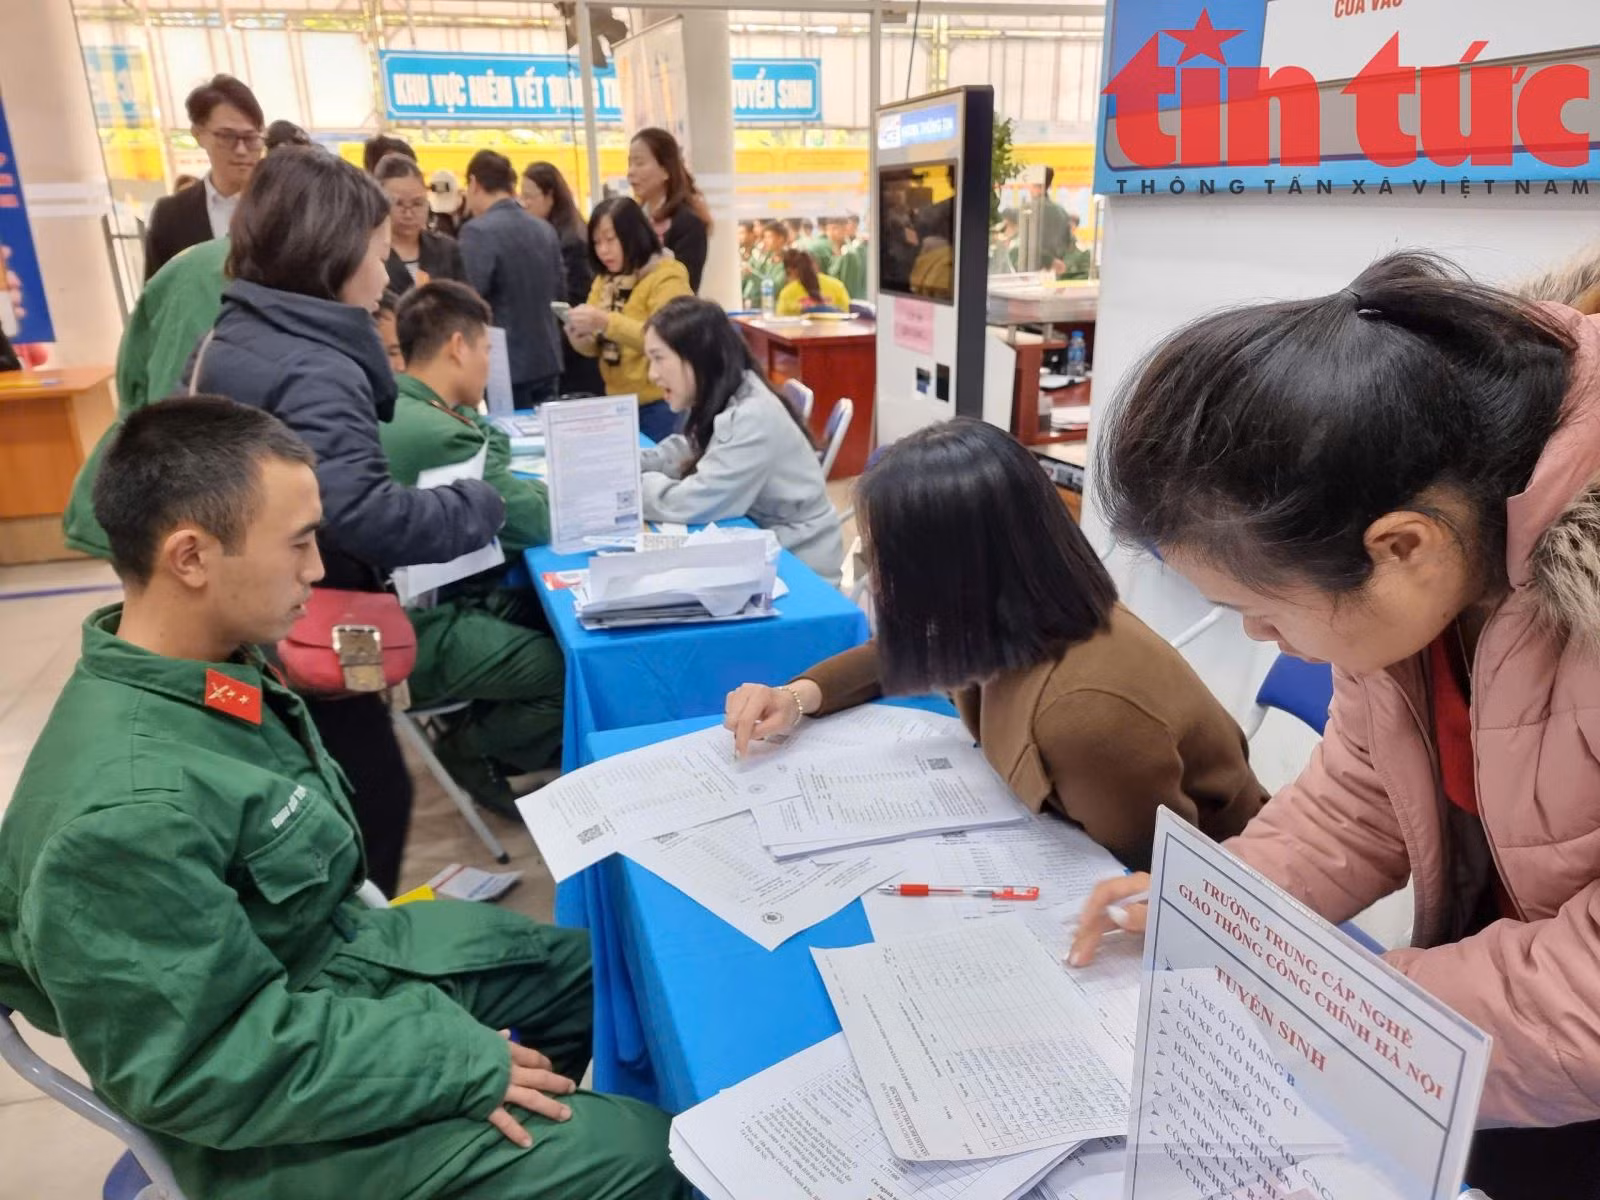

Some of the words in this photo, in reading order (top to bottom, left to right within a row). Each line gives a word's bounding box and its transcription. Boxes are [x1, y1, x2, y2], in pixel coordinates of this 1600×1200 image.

[393, 73, 430, 106] KHU
[1203, 878, 1261, 932] TRƯỜNG
[1264, 925, 1318, 976] TRUNG
[1321, 970, 1356, 1002] CẤP
[1178, 884, 1211, 916] GIAO
[1214, 910, 1263, 958] THÔNG
[1265, 954, 1311, 996] CÔNG
[1314, 991, 1371, 1044] CHÍNH
[1374, 1037, 1401, 1069] HÀ
[1405, 1060, 1444, 1101] NỘI
[1180, 976, 1199, 1000] LÁI
[1201, 994, 1216, 1016] XE
[1228, 1020, 1246, 1041] TÔ
[1247, 1037, 1284, 1076] HẠNG
[1171, 1062, 1189, 1085] LÁI
[1190, 1080, 1206, 1102] XE
[1176, 1021, 1206, 1055] CÔNG
[1207, 1050, 1240, 1089] NGHỆ
[1254, 1093, 1272, 1117] TÔ
[1178, 999, 1196, 1022] LÁI
[1198, 1017, 1213, 1038] XE
[1226, 1042, 1243, 1064] TÔ
[1245, 1060, 1281, 1100] HẠNG
[1198, 1065, 1230, 1102] CÔNG
[1278, 1020, 1327, 1073] SINH
[1166, 1123, 1195, 1160] CÔNG
